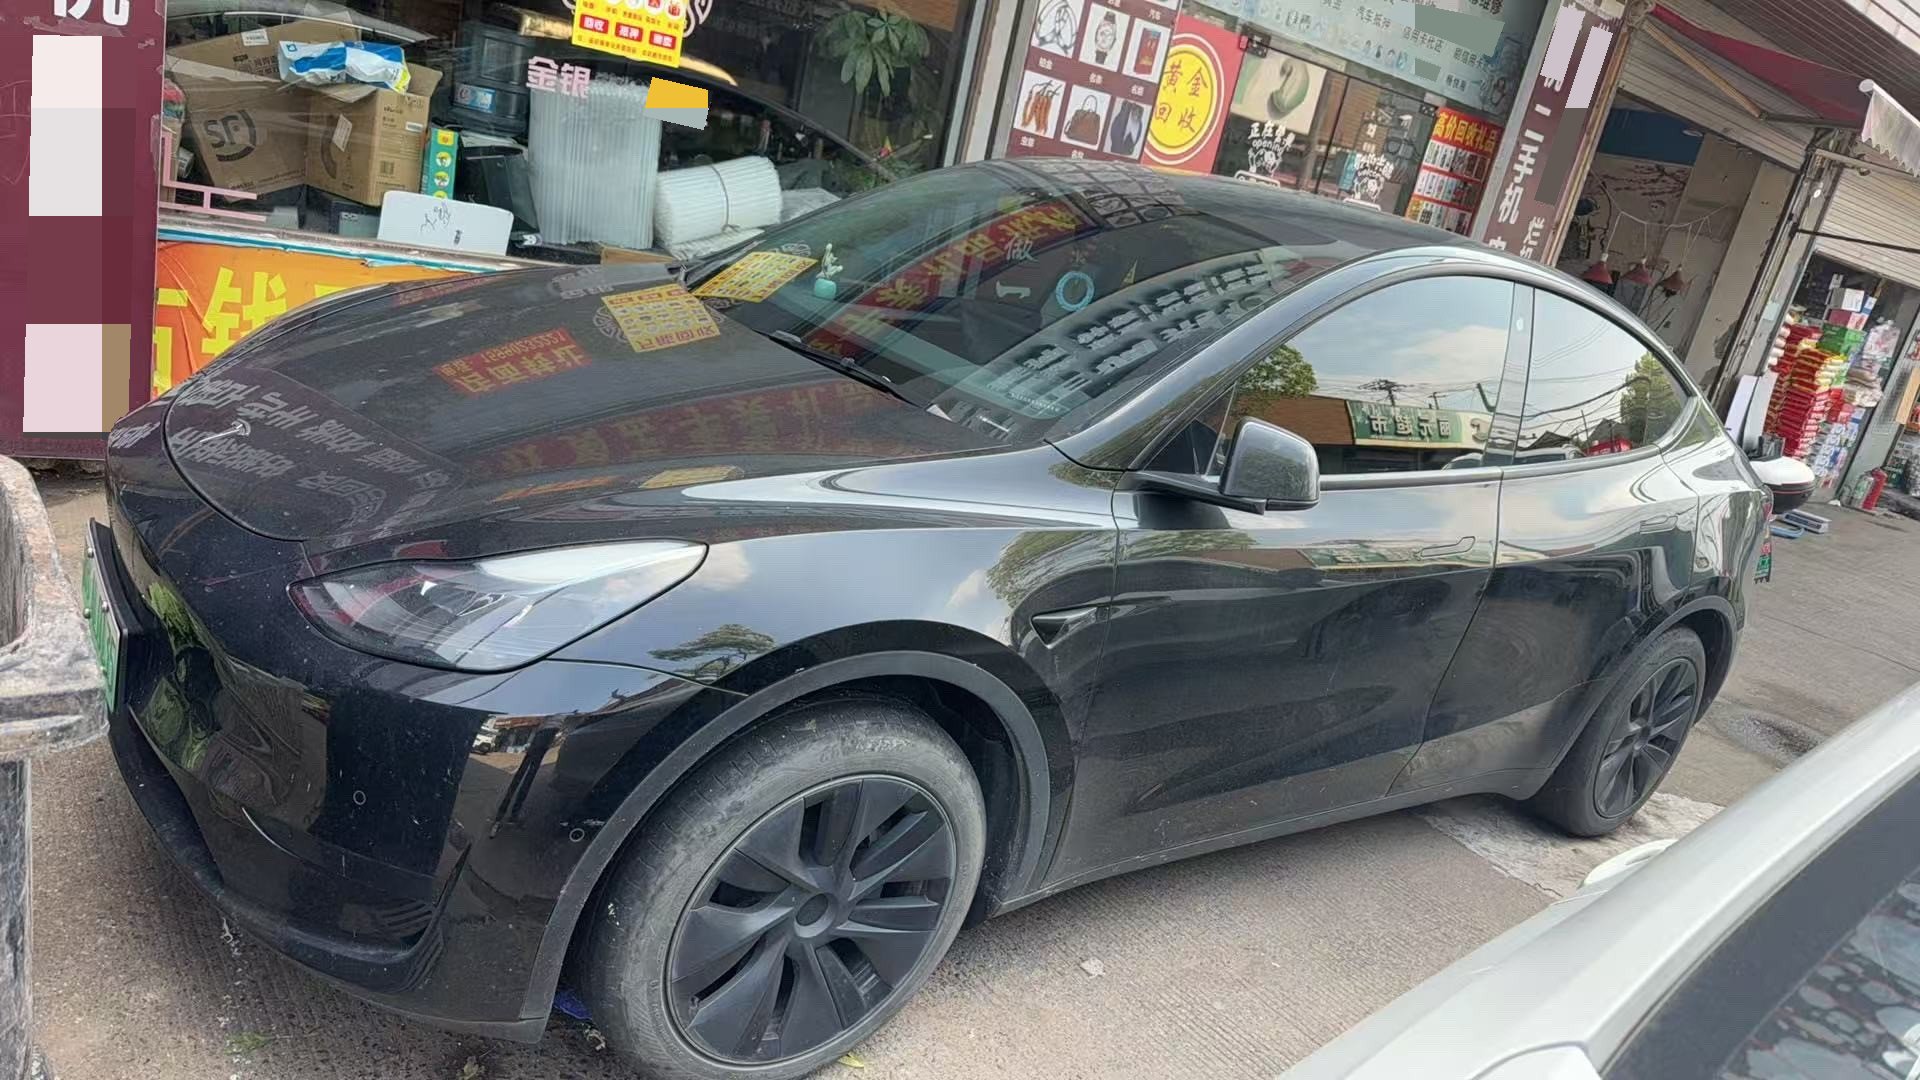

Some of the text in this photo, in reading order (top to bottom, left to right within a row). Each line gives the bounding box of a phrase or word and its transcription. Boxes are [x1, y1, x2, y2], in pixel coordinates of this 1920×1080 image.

[1355, 6, 1392, 30] 汽车抵押
[1402, 25, 1444, 53] 信用卡代还
[526, 55, 591, 99] 金银
[1164, 59, 1209, 97] 黄金
[1155, 102, 1196, 133] 回收
[1433, 111, 1498, 154] 高价回收礼品
